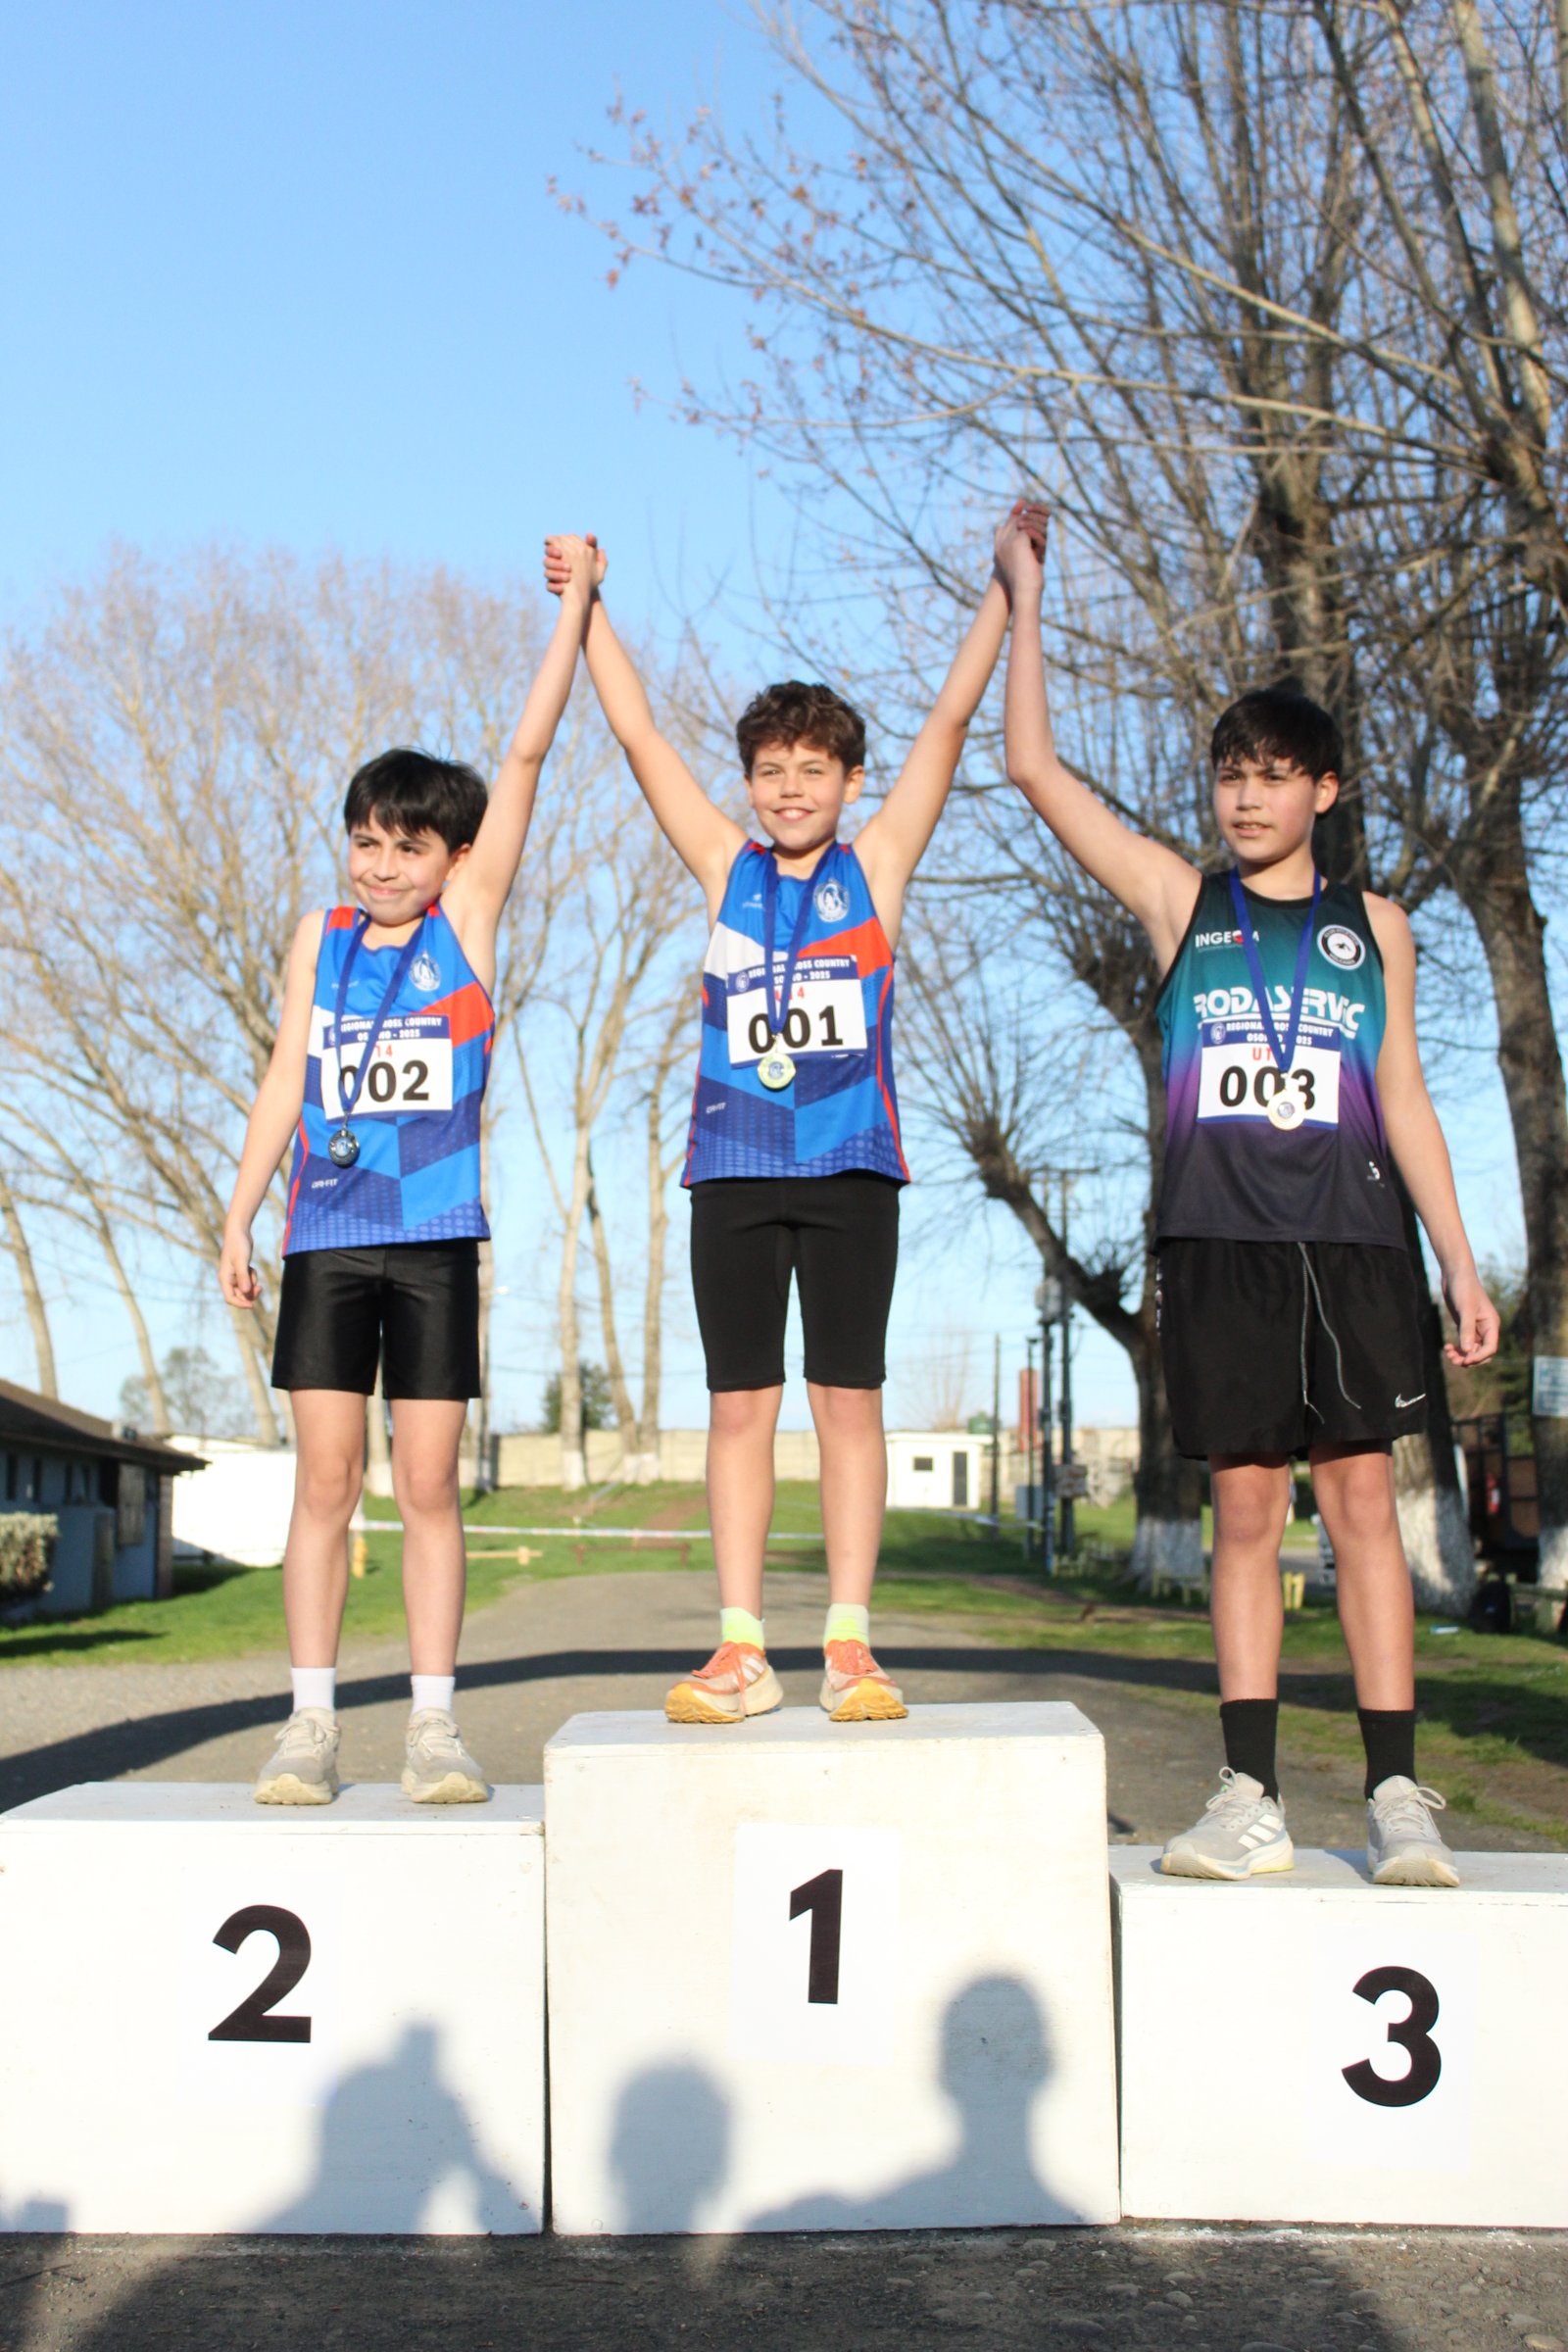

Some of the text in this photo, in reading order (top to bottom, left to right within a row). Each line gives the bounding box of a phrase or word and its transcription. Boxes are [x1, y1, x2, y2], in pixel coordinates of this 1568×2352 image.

[813, 957, 850, 968] COUNTRY
[809, 970, 831, 980] 2025
[404, 1016, 442, 1028] COUNTRY
[749, 1005, 843, 1054] 001
[399, 1029, 420, 1039] 2025
[1298, 1023, 1334, 1038] COUNTRY
[1296, 1035, 1312, 1046] 025
[1219, 1065, 1315, 1110] 003
[791, 1870, 842, 2004] 1
[209, 1906, 311, 2042] 2
[1343, 1967, 1441, 2107] 3
